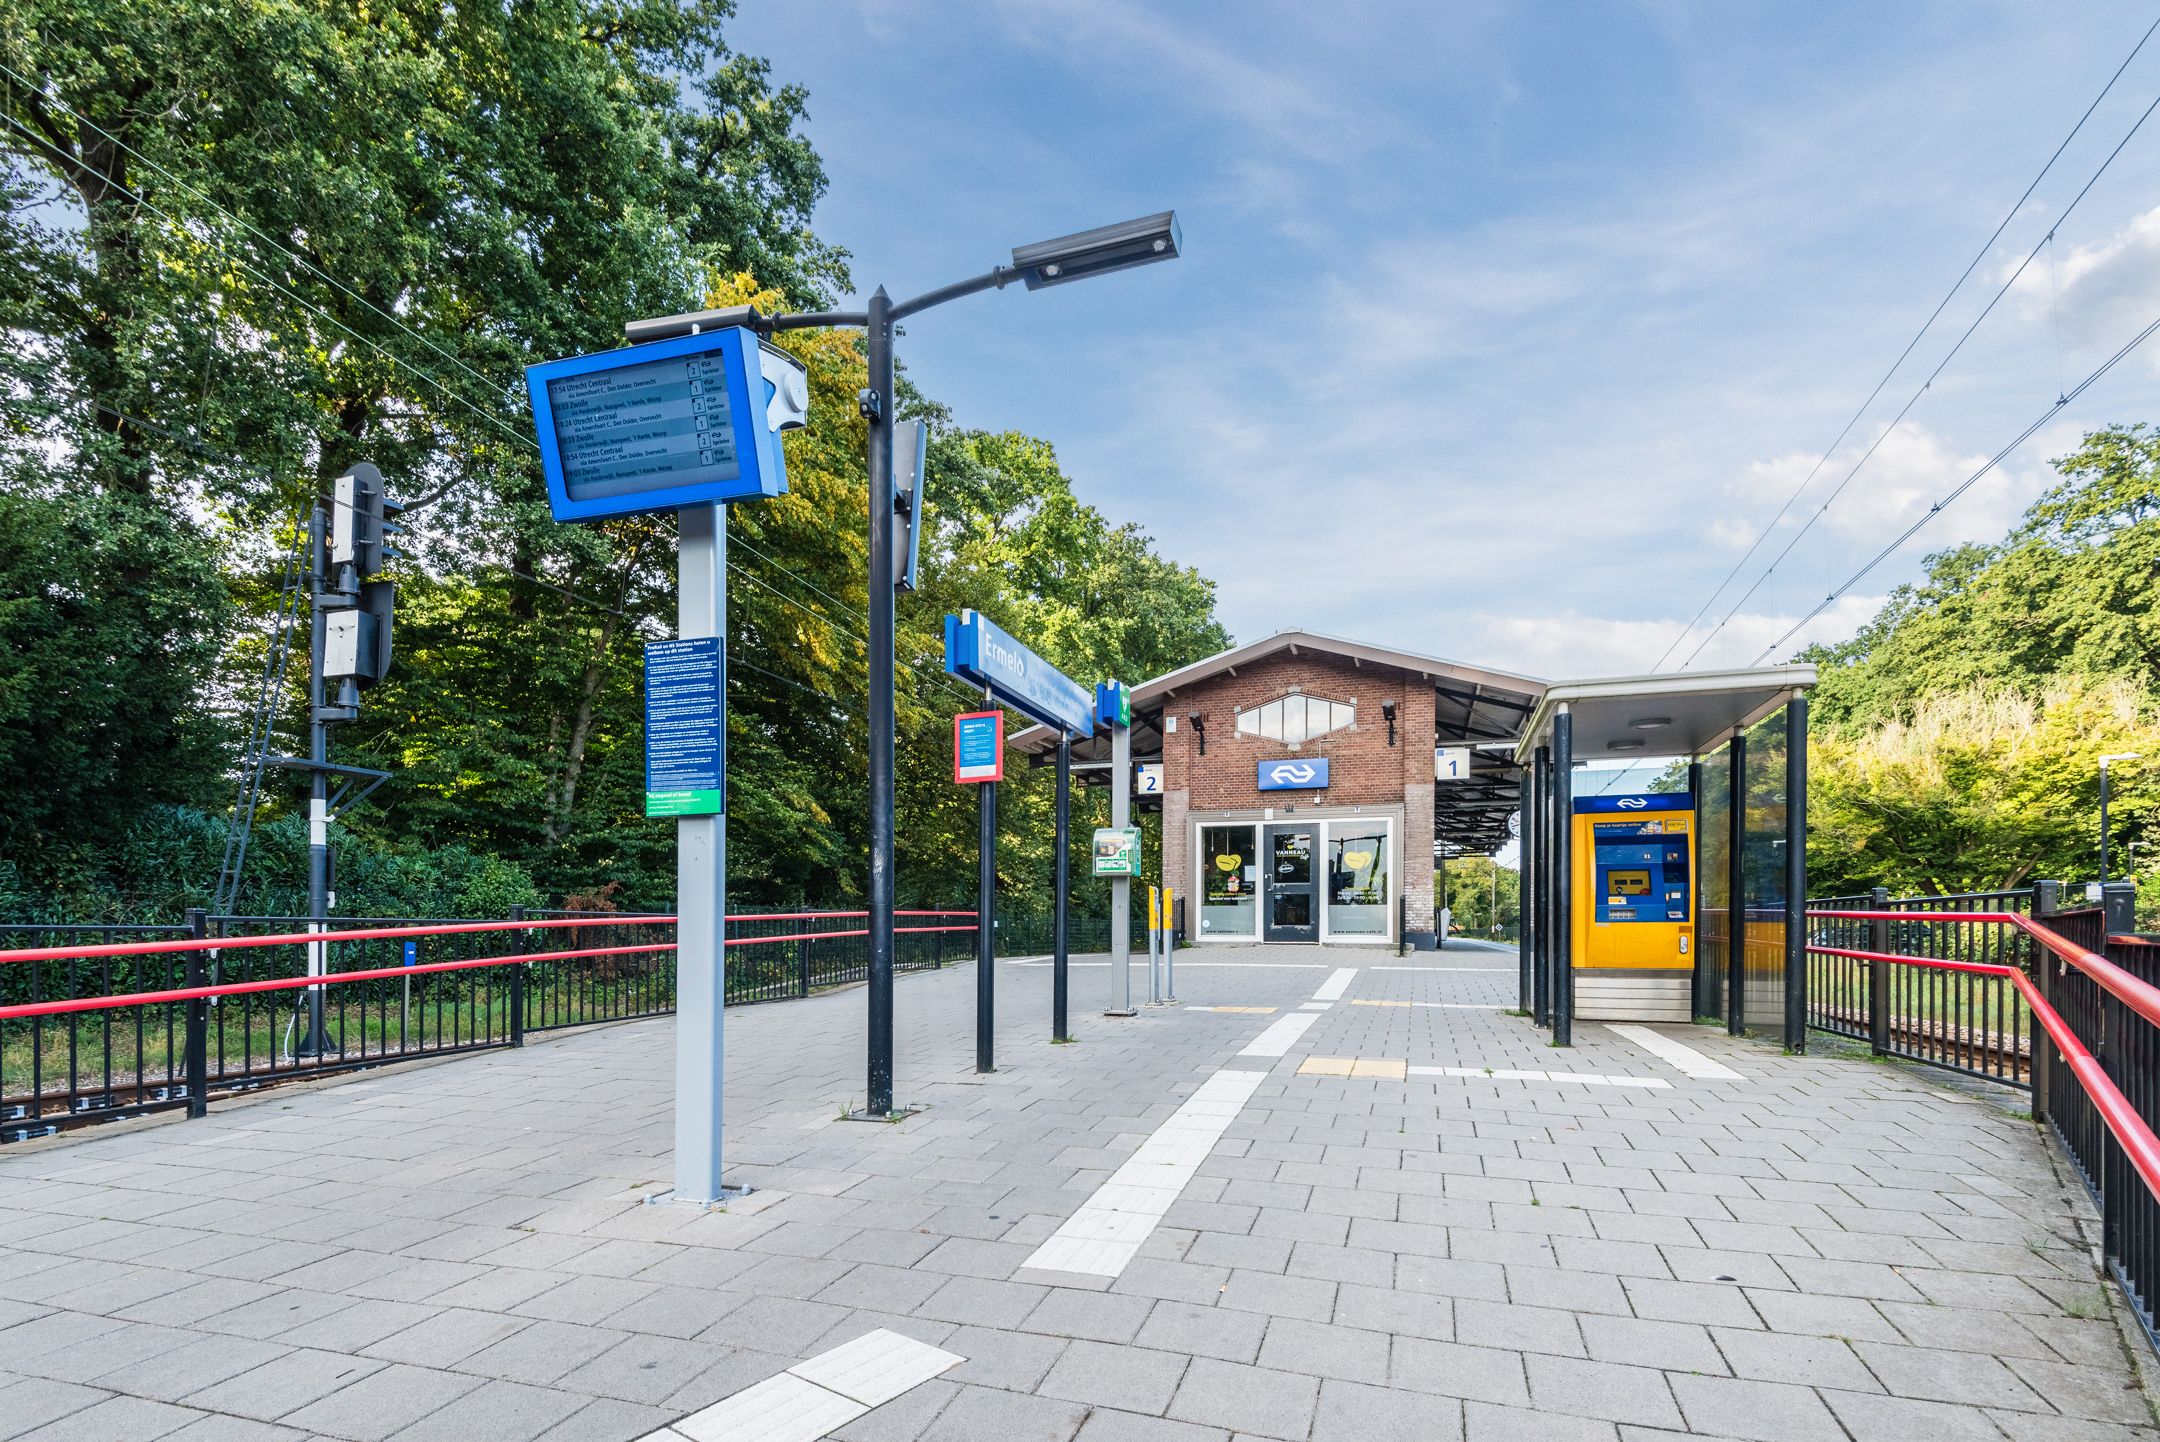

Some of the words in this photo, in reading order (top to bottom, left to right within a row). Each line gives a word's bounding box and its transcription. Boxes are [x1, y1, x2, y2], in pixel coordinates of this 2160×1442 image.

[567, 382, 586, 391] Utrecht
[588, 377, 612, 387] Centraal
[576, 389, 600, 398] Amersfoort
[634, 378, 656, 387] Overvecht
[570, 400, 588, 409] Zwolle
[573, 417, 593, 426] Utrecht
[594, 412, 618, 422] Centraal
[582, 423, 606, 432] Amersfoort
[640, 414, 662, 422] Overvecht
[710, 421, 727, 429] Sprinter
[576, 434, 594, 443] Zwolle
[579, 450, 599, 459] Utrecht
[600, 446, 623, 455] Centraal
[588, 457, 612, 465] Amersfoort
[645, 448, 668, 456] Overvecht
[582, 467, 600, 476] Zwolle
[986, 632, 1024, 677] Ermelo
[1449, 760, 1456, 776] 1
[1146, 776, 1156, 791] 2
